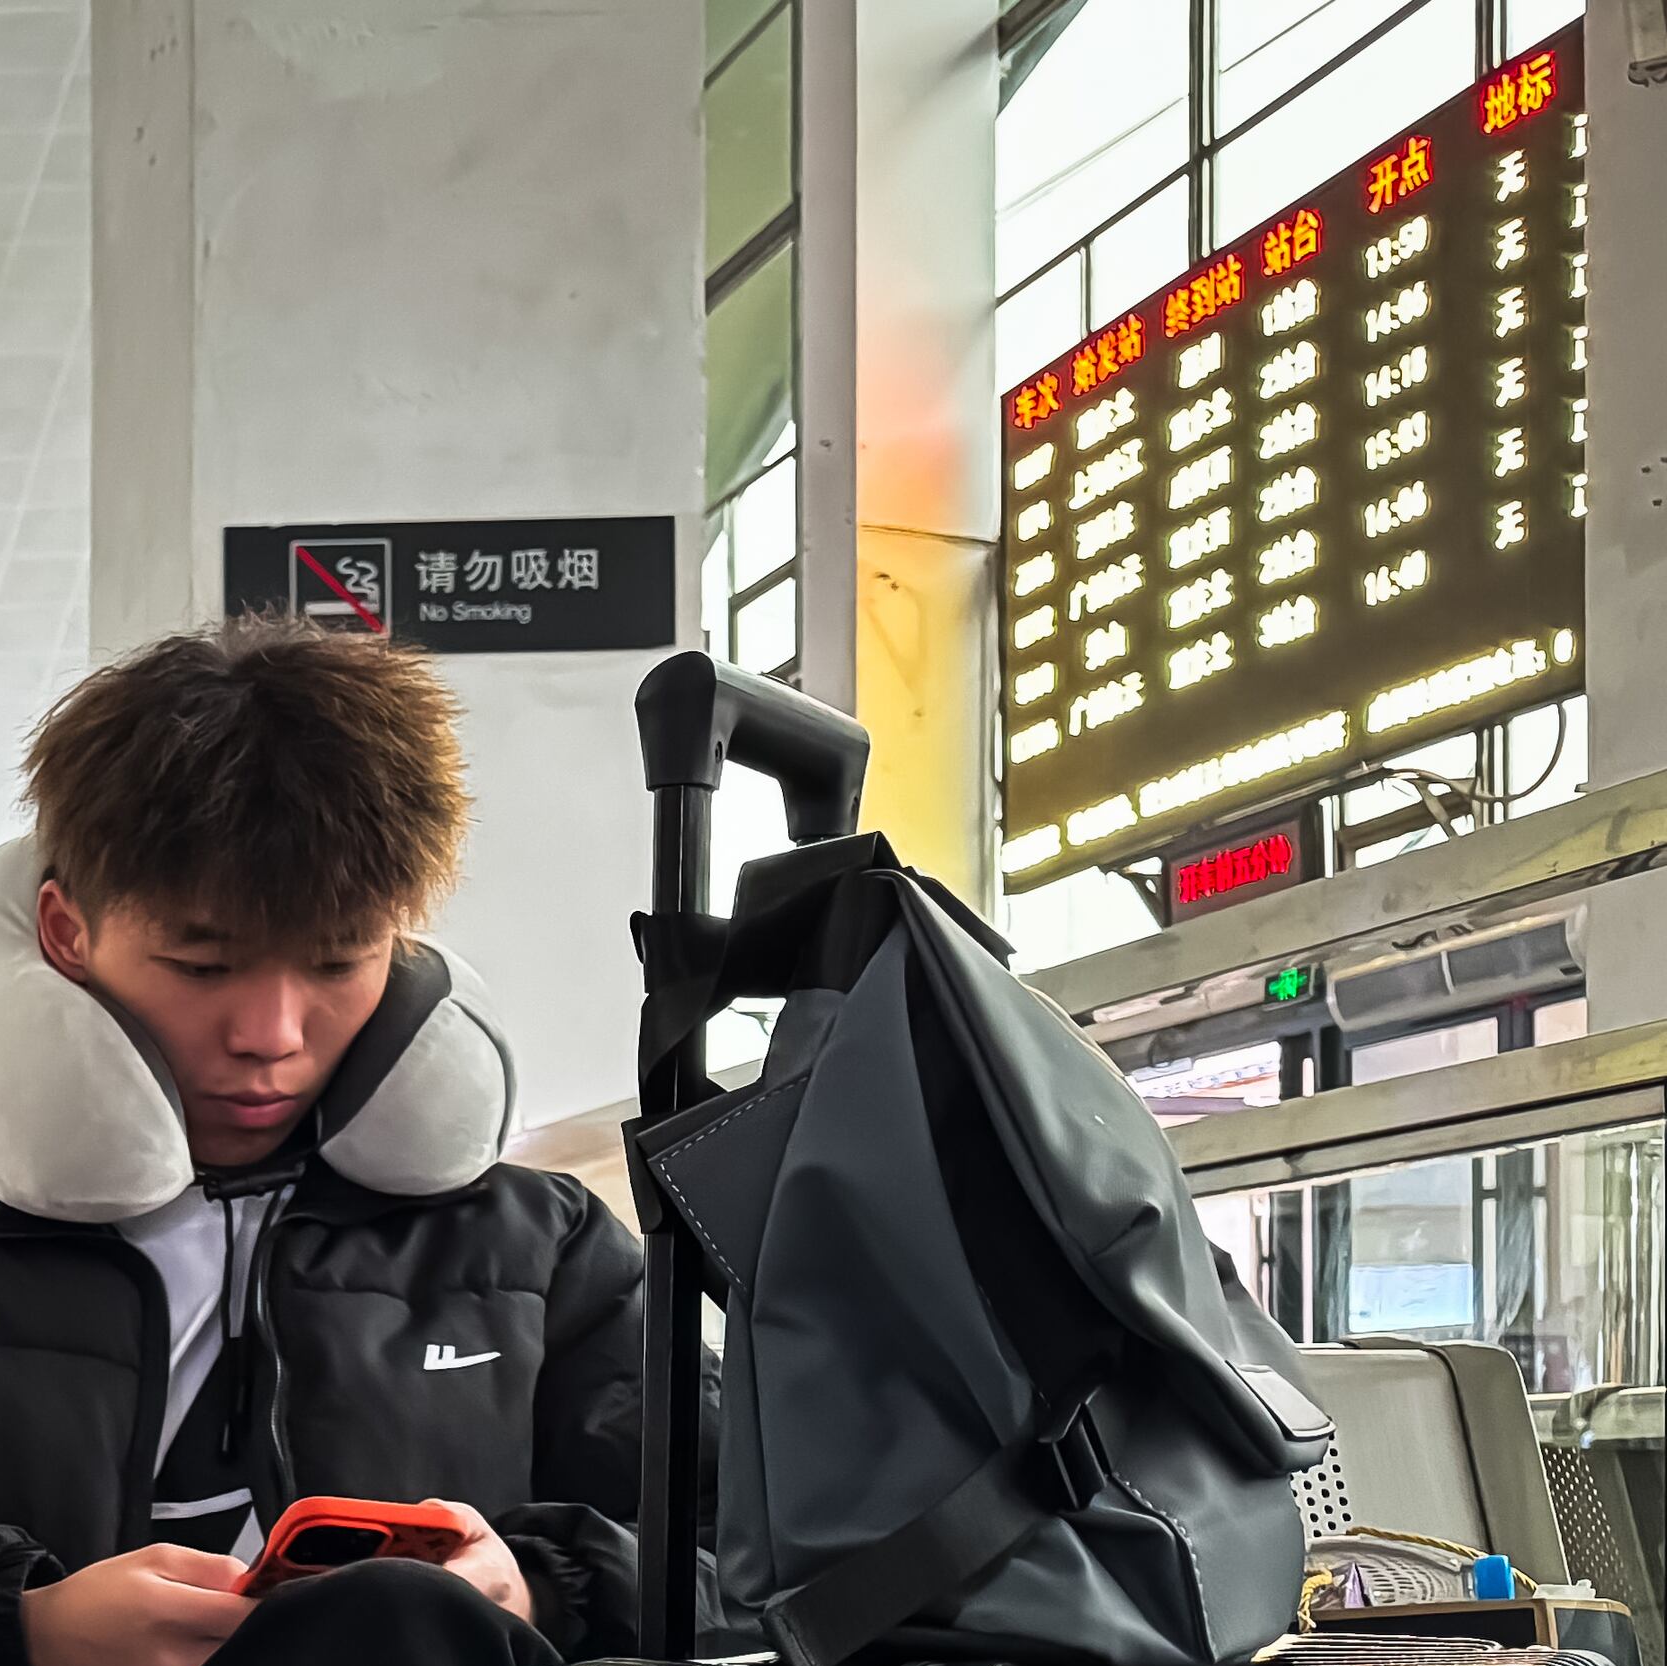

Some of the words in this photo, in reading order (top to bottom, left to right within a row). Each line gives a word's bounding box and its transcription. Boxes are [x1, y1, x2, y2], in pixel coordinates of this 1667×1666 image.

[1263, 210, 1319, 275] 站台
[1368, 138, 1432, 213] 开点
[1483, 53, 1553, 133] 地标
[414, 549, 599, 594] 请勿吸烟
[419, 602, 448, 622] No
[452, 601, 532, 624] Smoking
